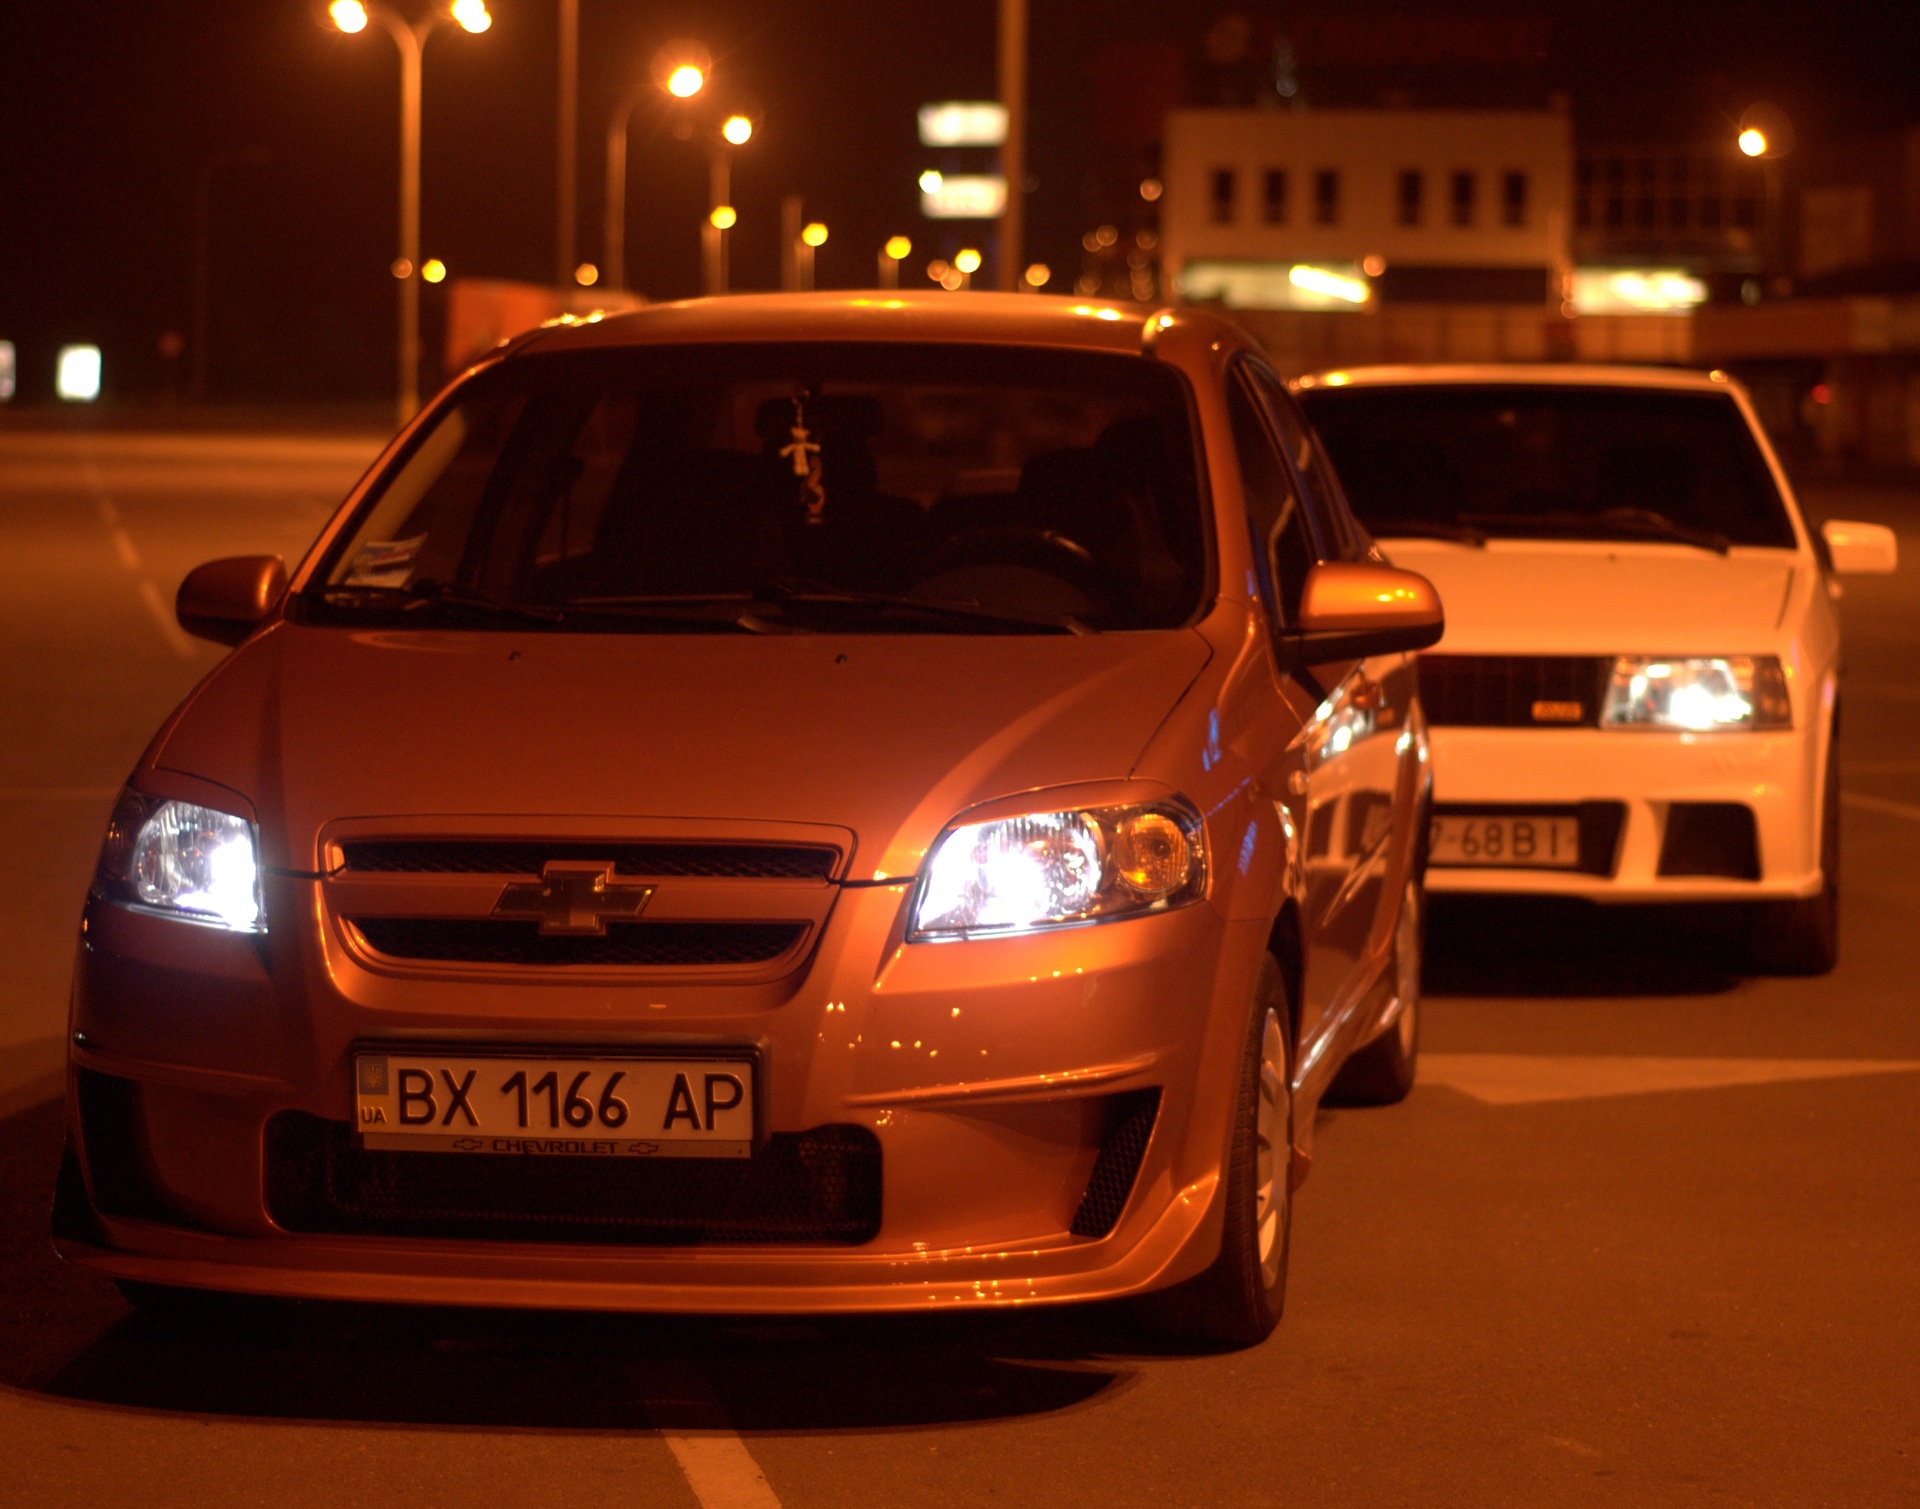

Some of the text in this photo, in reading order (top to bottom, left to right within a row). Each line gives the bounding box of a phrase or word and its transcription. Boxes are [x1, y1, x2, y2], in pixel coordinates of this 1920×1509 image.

[398, 1068, 744, 1131] BX 1166 AP
[361, 1106, 387, 1124] UA
[492, 1138, 619, 1155] CHEVROLET
